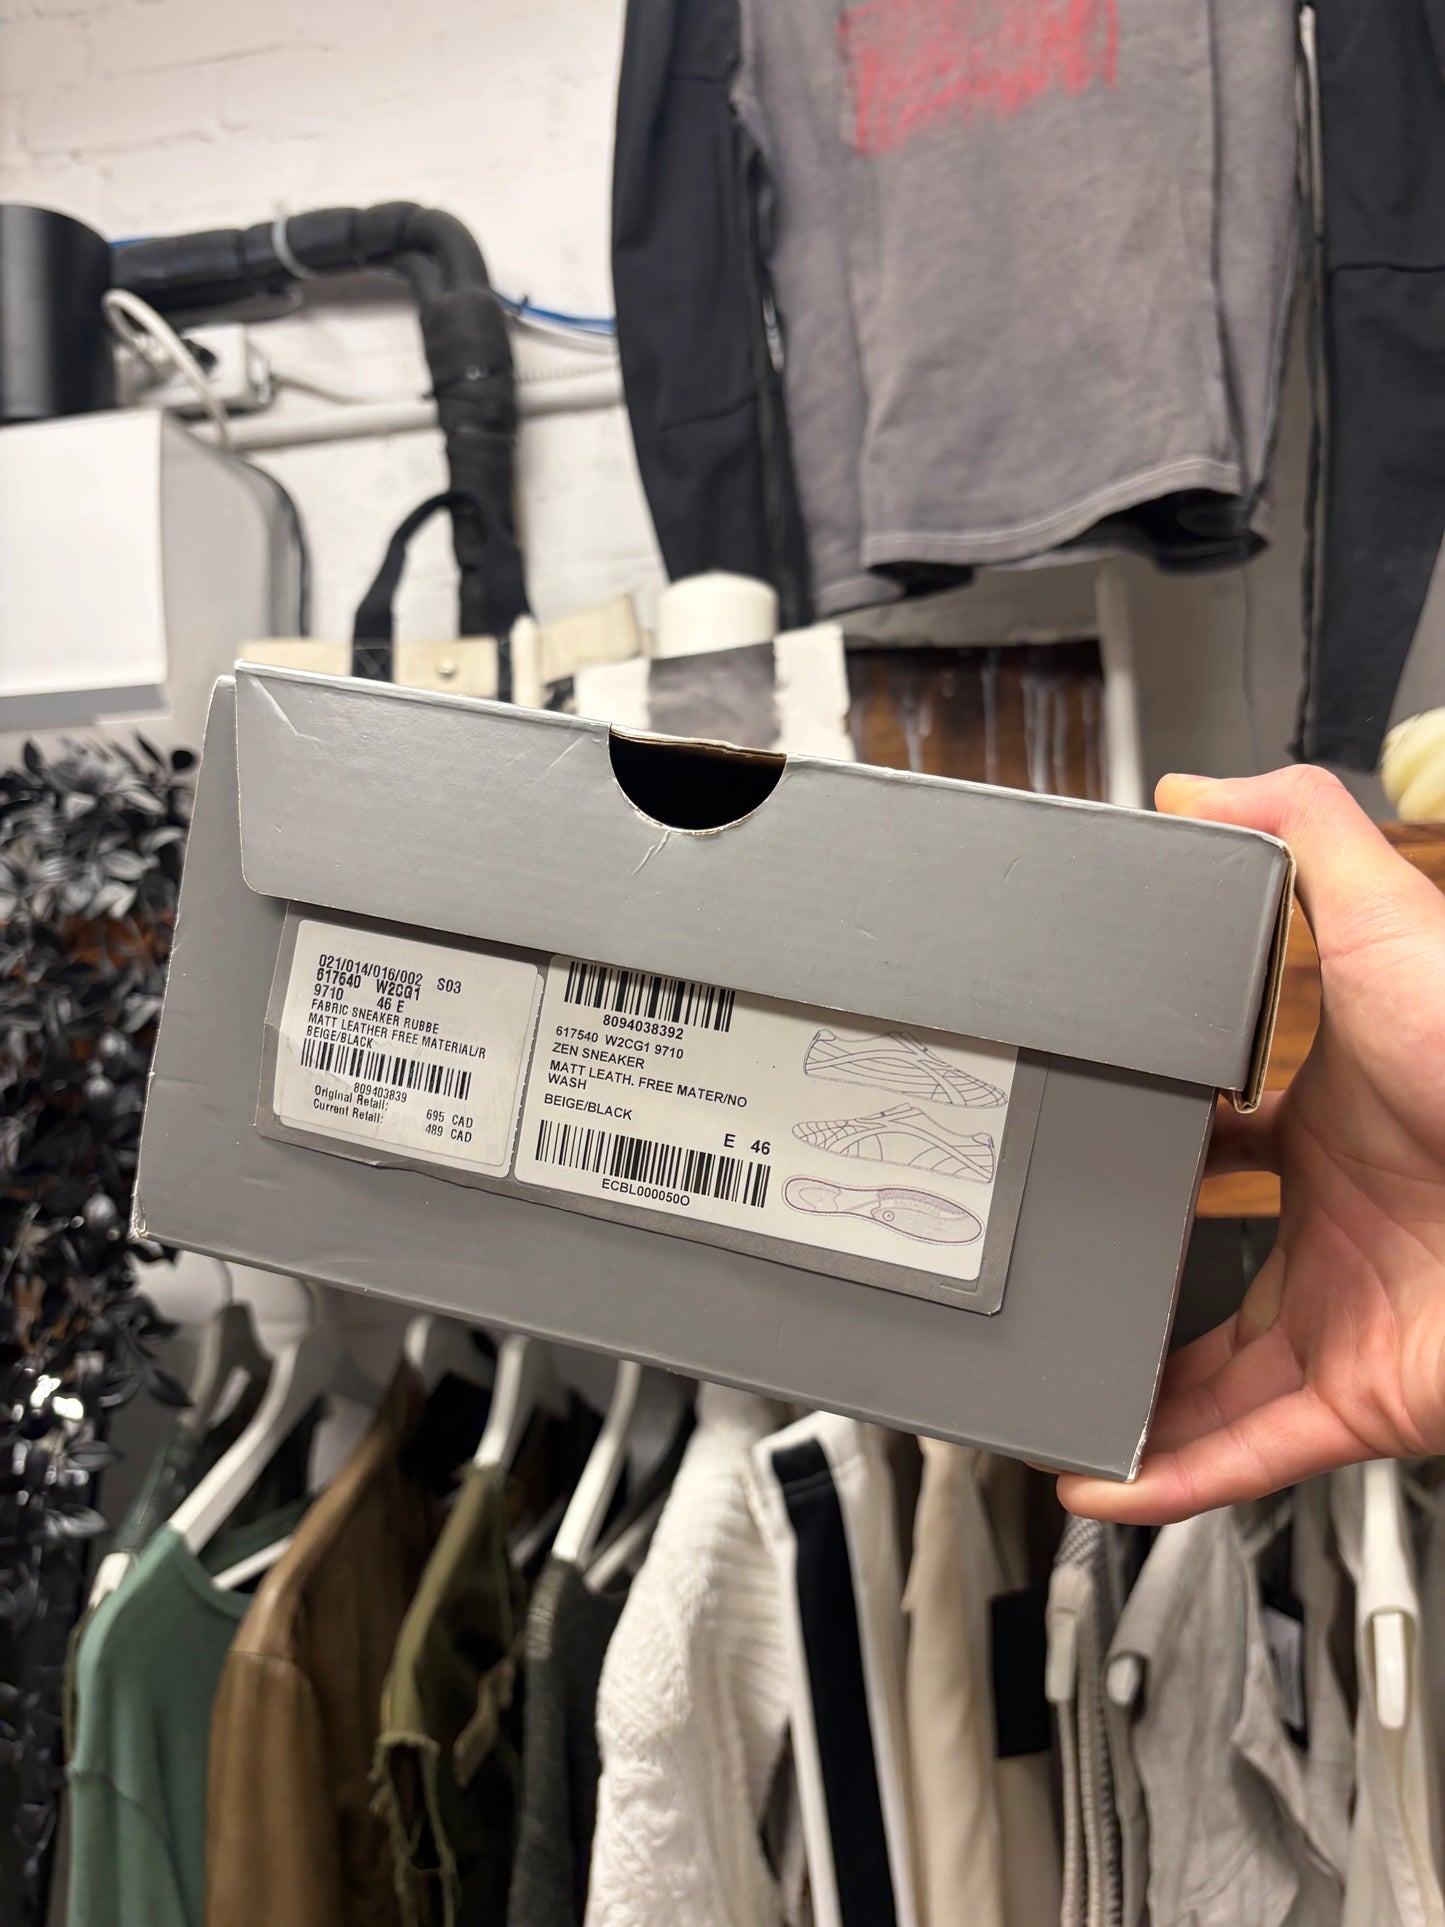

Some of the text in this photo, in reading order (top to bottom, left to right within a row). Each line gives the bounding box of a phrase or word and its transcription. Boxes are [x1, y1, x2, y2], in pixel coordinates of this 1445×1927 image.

[319, 954, 462, 994] 021/014/016/002 S03
[314, 984, 405, 1013] 9710 46 E
[311, 999, 439, 1034] FABRIC SNEAKER RUBBE
[602, 1014, 684, 1039] 8094038392
[306, 1026, 374, 1049] BEIGE/BLACK
[308, 1013, 486, 1059] MATT LEATHER FREE MATERIAL/R
[555, 1026, 684, 1059] 617540 W2CG1 9710
[552, 1042, 645, 1069] ZEN SNEAKER
[354, 1082, 407, 1103] 809403839
[548, 1073, 587, 1090] WASH
[550, 1060, 748, 1107] MATT LEATH. FREE MATER/NO
[313, 1098, 472, 1143] Current Retail: 489 CAD
[314, 1085, 473, 1128] Original Retail: 695 CAD
[544, 1093, 633, 1120] BEIGE/BLACK
[723, 1133, 771, 1155] E 46
